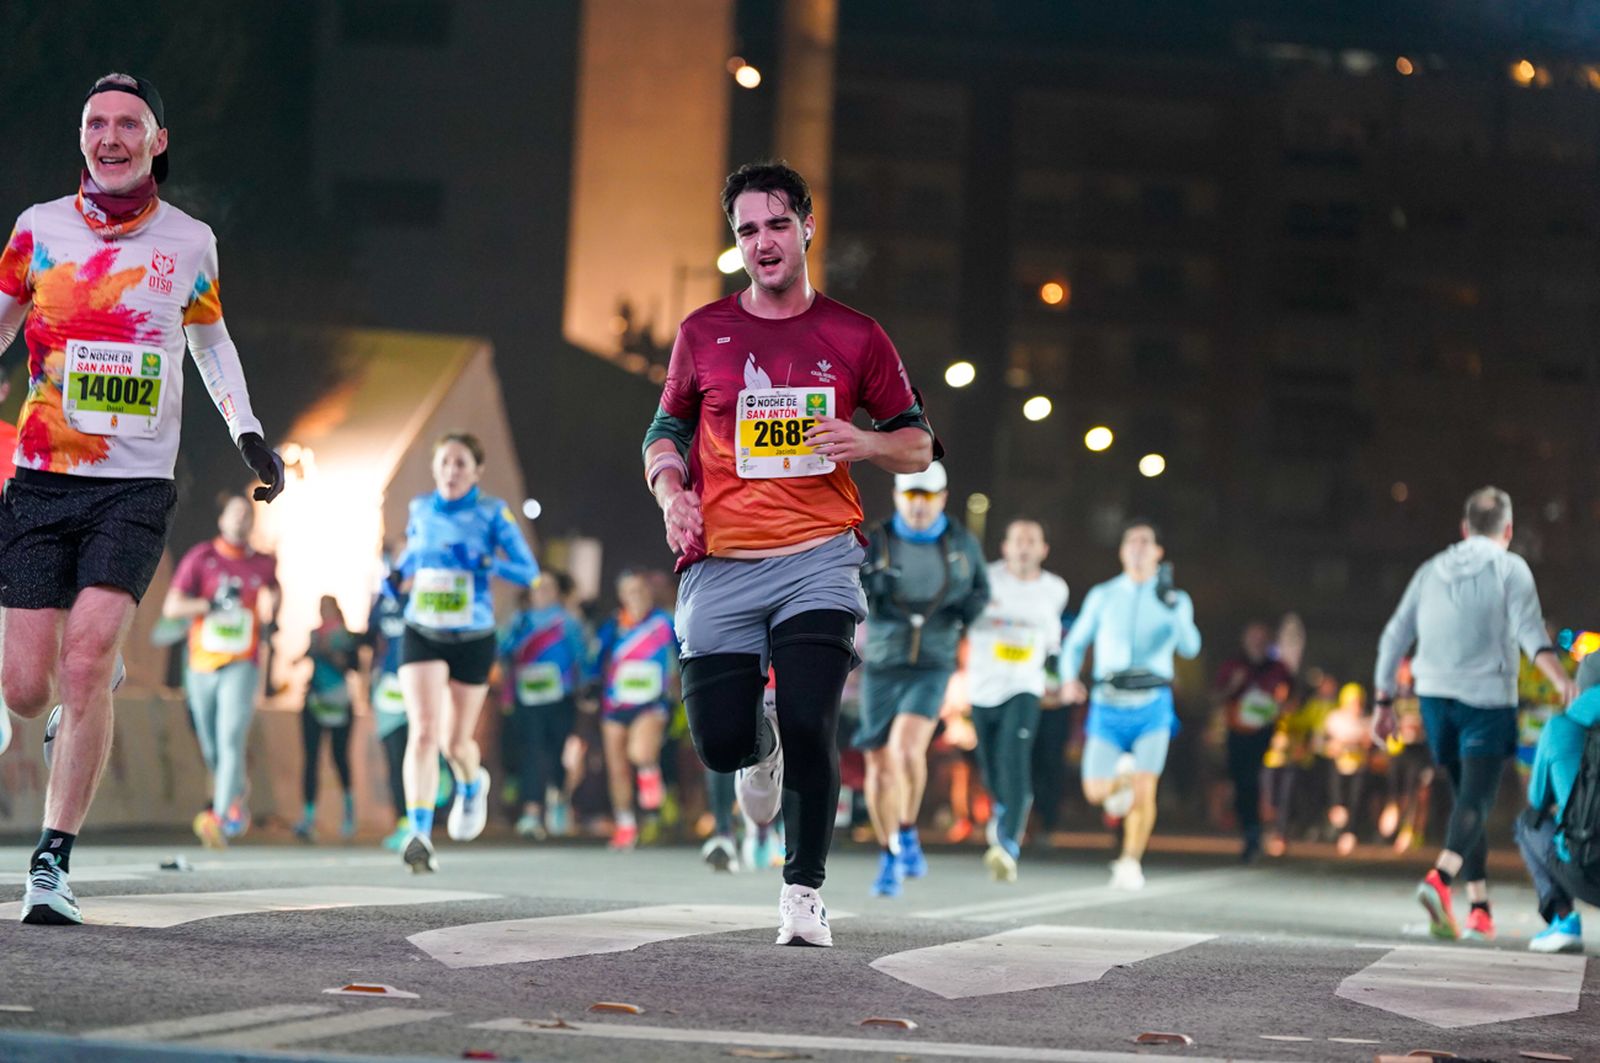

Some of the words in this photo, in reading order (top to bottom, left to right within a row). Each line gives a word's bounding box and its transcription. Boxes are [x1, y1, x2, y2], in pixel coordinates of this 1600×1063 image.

[149, 275, 173, 293] OTSO
[89, 352, 119, 362] NOCHE
[121, 354, 133, 363] DE
[76, 362, 97, 373] SAN
[99, 363, 133, 375] ANTÓN
[77, 374, 154, 406] 14002
[757, 398, 784, 407] NOCHE
[786, 398, 797, 406] DE
[746, 409, 767, 419] SAN
[767, 408, 798, 419] ANTÓN
